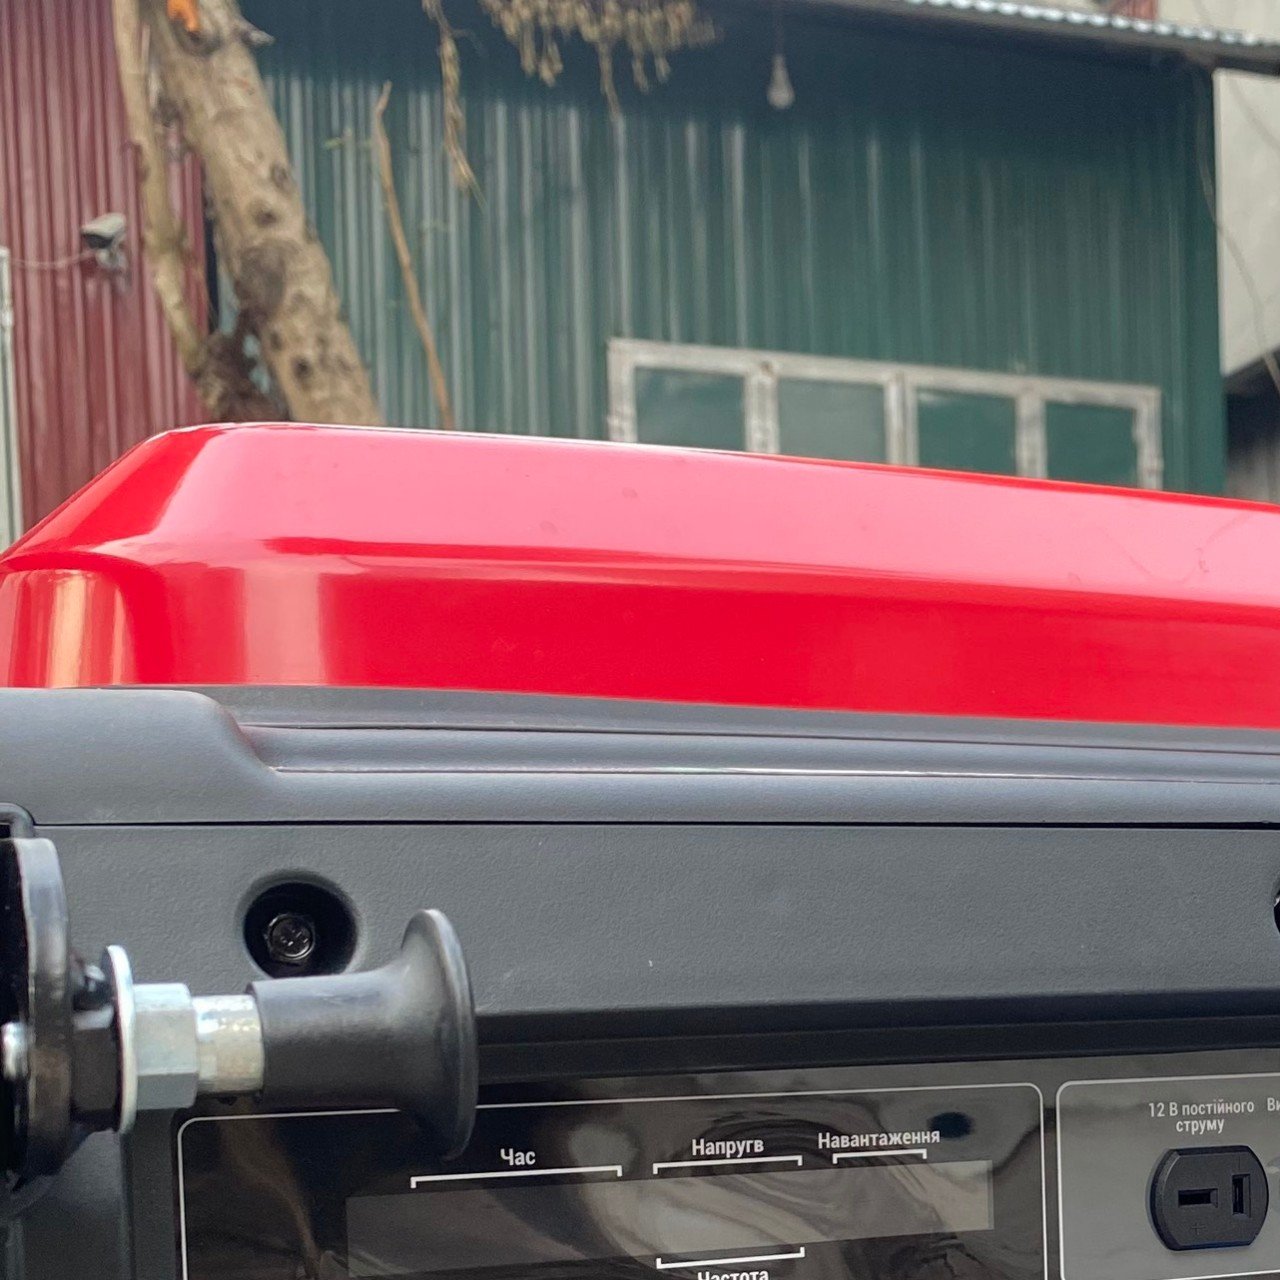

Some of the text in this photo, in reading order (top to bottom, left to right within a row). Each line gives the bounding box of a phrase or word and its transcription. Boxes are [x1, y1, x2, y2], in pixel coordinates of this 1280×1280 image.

[1148, 1098, 1255, 1117] 12 В постійного
[1176, 1117, 1224, 1134] струму
[817, 1127, 941, 1150] Навантаження
[500, 1147, 536, 1167] Час
